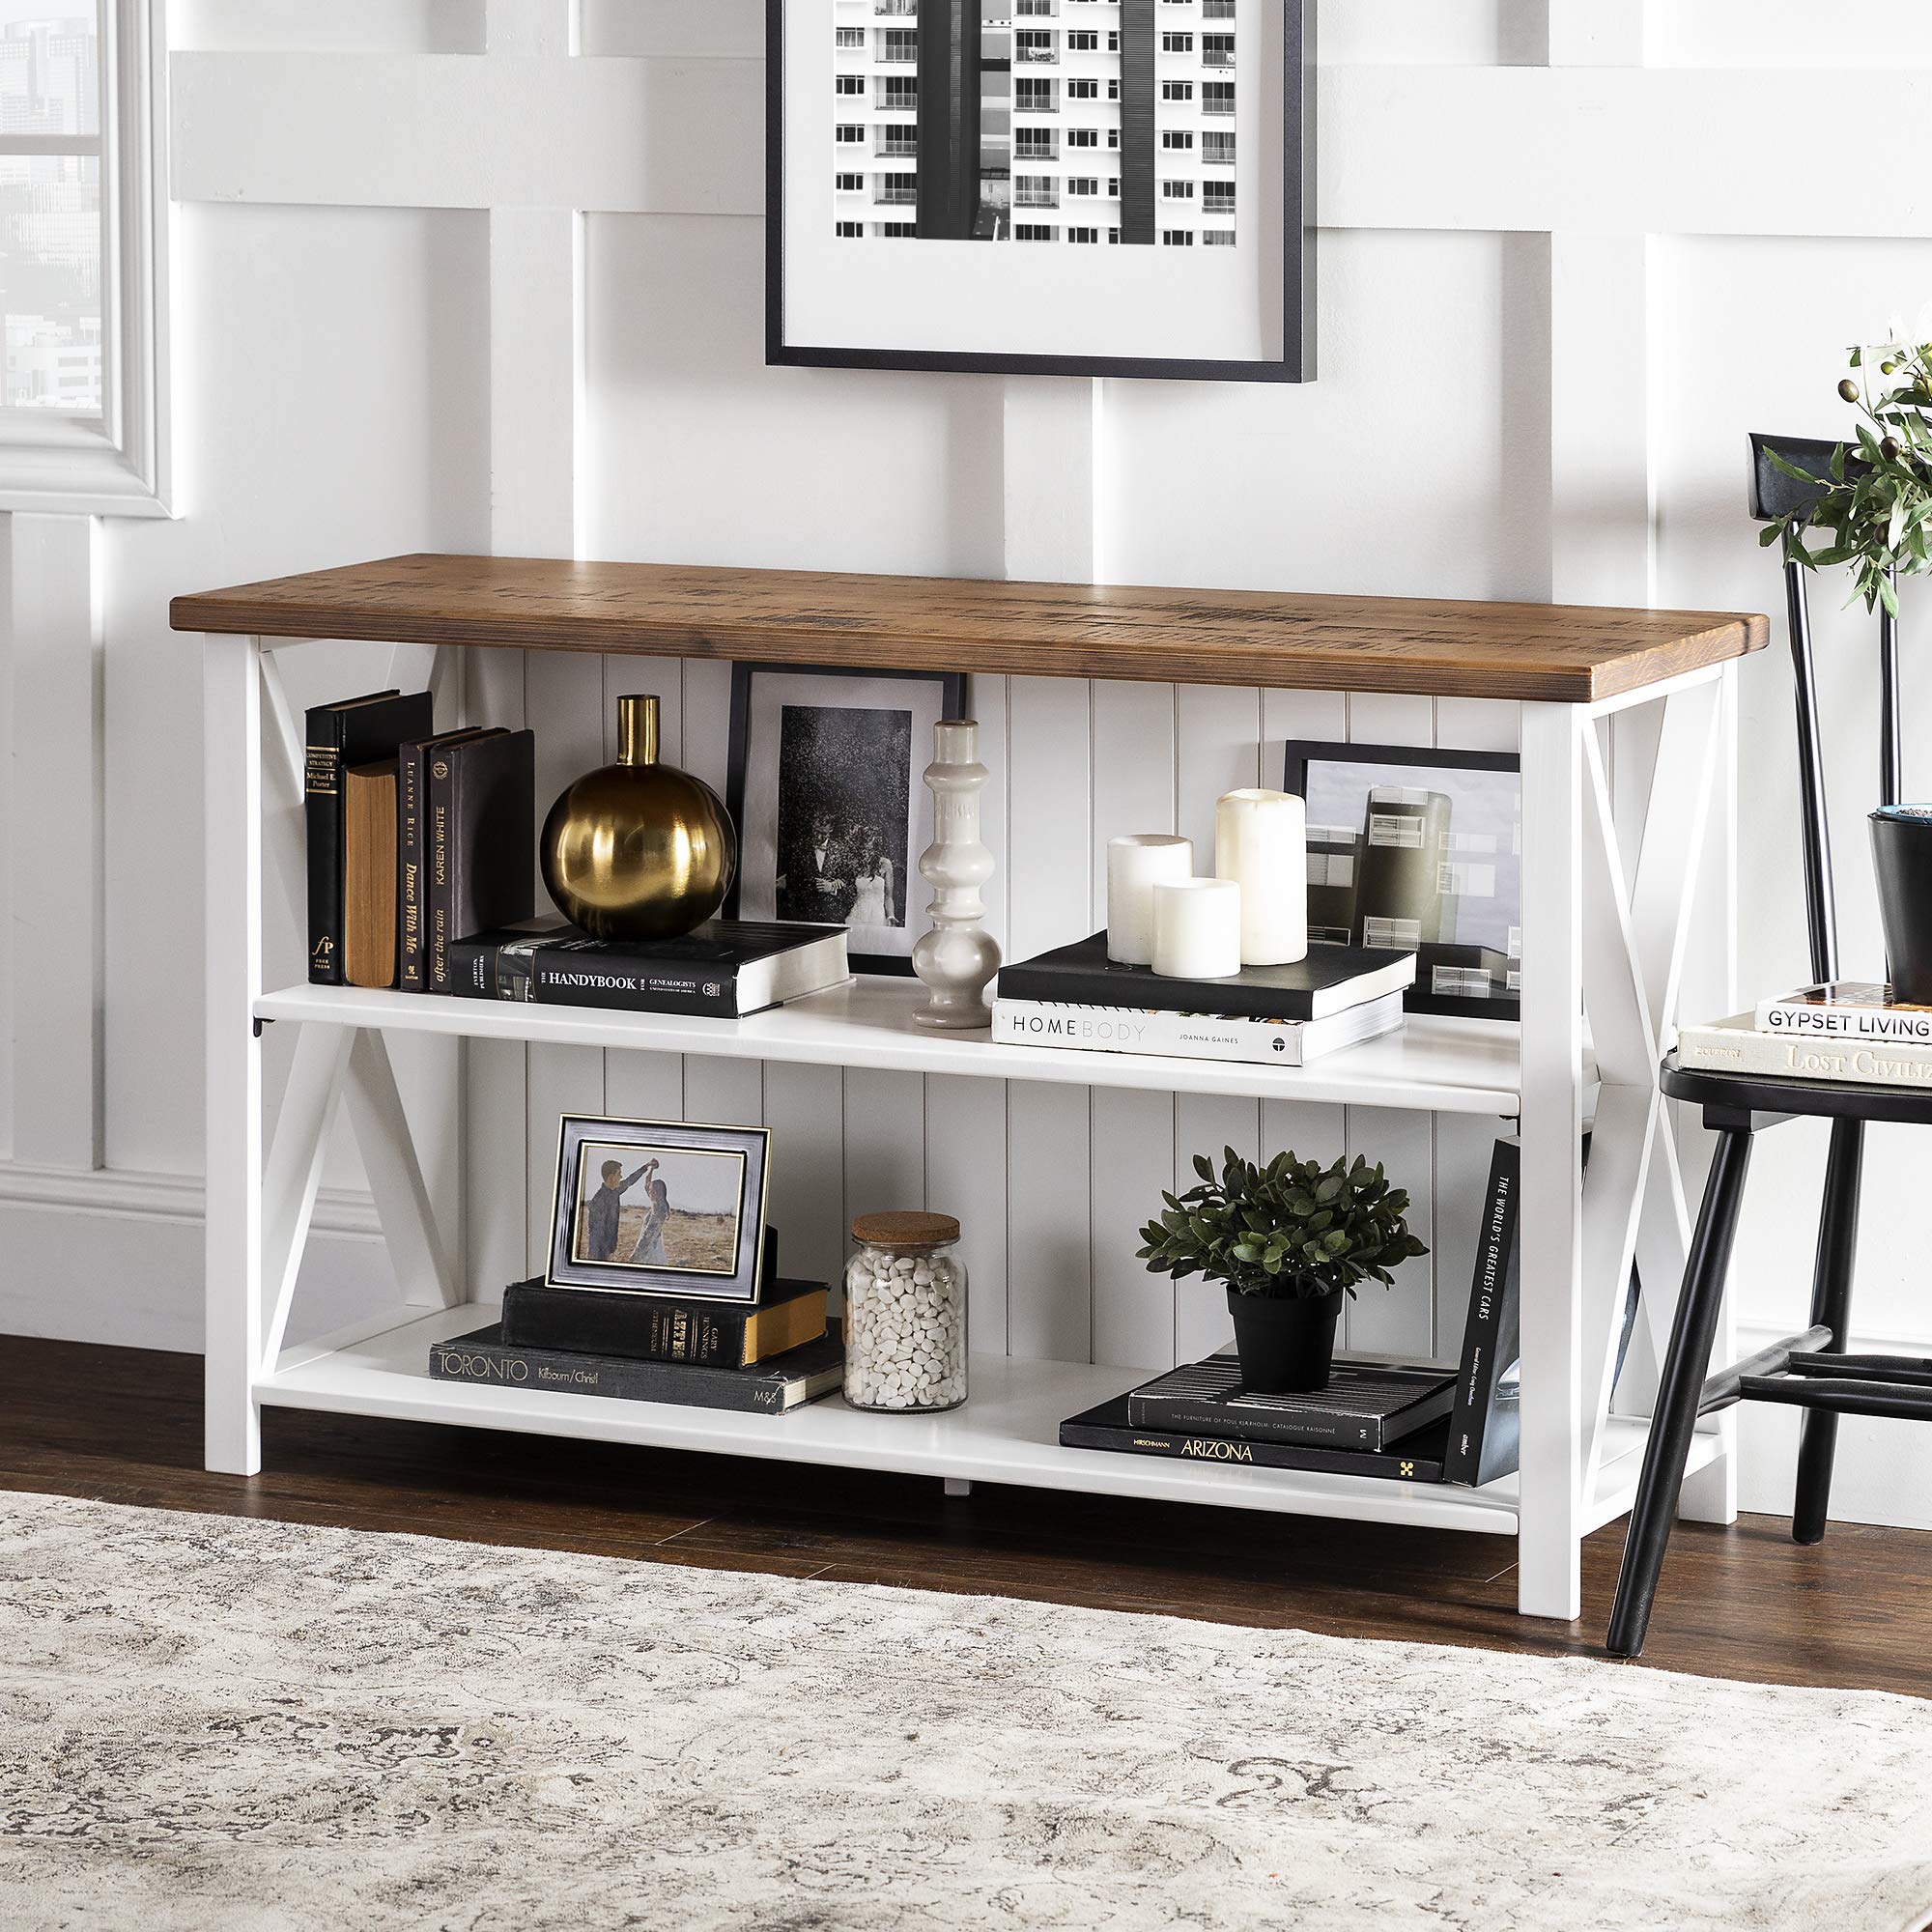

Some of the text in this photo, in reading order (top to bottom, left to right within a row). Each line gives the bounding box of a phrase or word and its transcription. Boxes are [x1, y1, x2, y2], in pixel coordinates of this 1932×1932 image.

[306, 772, 329, 781] Michael
[407, 761, 415, 846] LUANNE RICE
[436, 807, 444, 885] KAREN WHITE
[406, 862, 417, 954] Dance With Me
[435, 909, 446, 982] after the rain
[549, 972, 637, 990] HANDYBOOK
[649, 978, 696, 988] GENEALOGISTS
[1013, 1015, 1146, 1041] HOMEBODY
[1769, 1010, 1929, 1037] GYPSET LIVING
[1179, 1034, 1238, 1044] JOANNA GAINES
[1478, 1176, 1510, 1321] THE WORLD'S GREATEST CARS
[710, 1327, 719, 1350] GARY
[438, 1351, 528, 1381] TORONTO
[1183, 1414, 1211, 1423] FURNITURE
[1272, 1423, 1304, 1432] CATALOGUE
[1180, 1439, 1253, 1462] ARIZONA
[1461, 1434, 1469, 1456] amber
